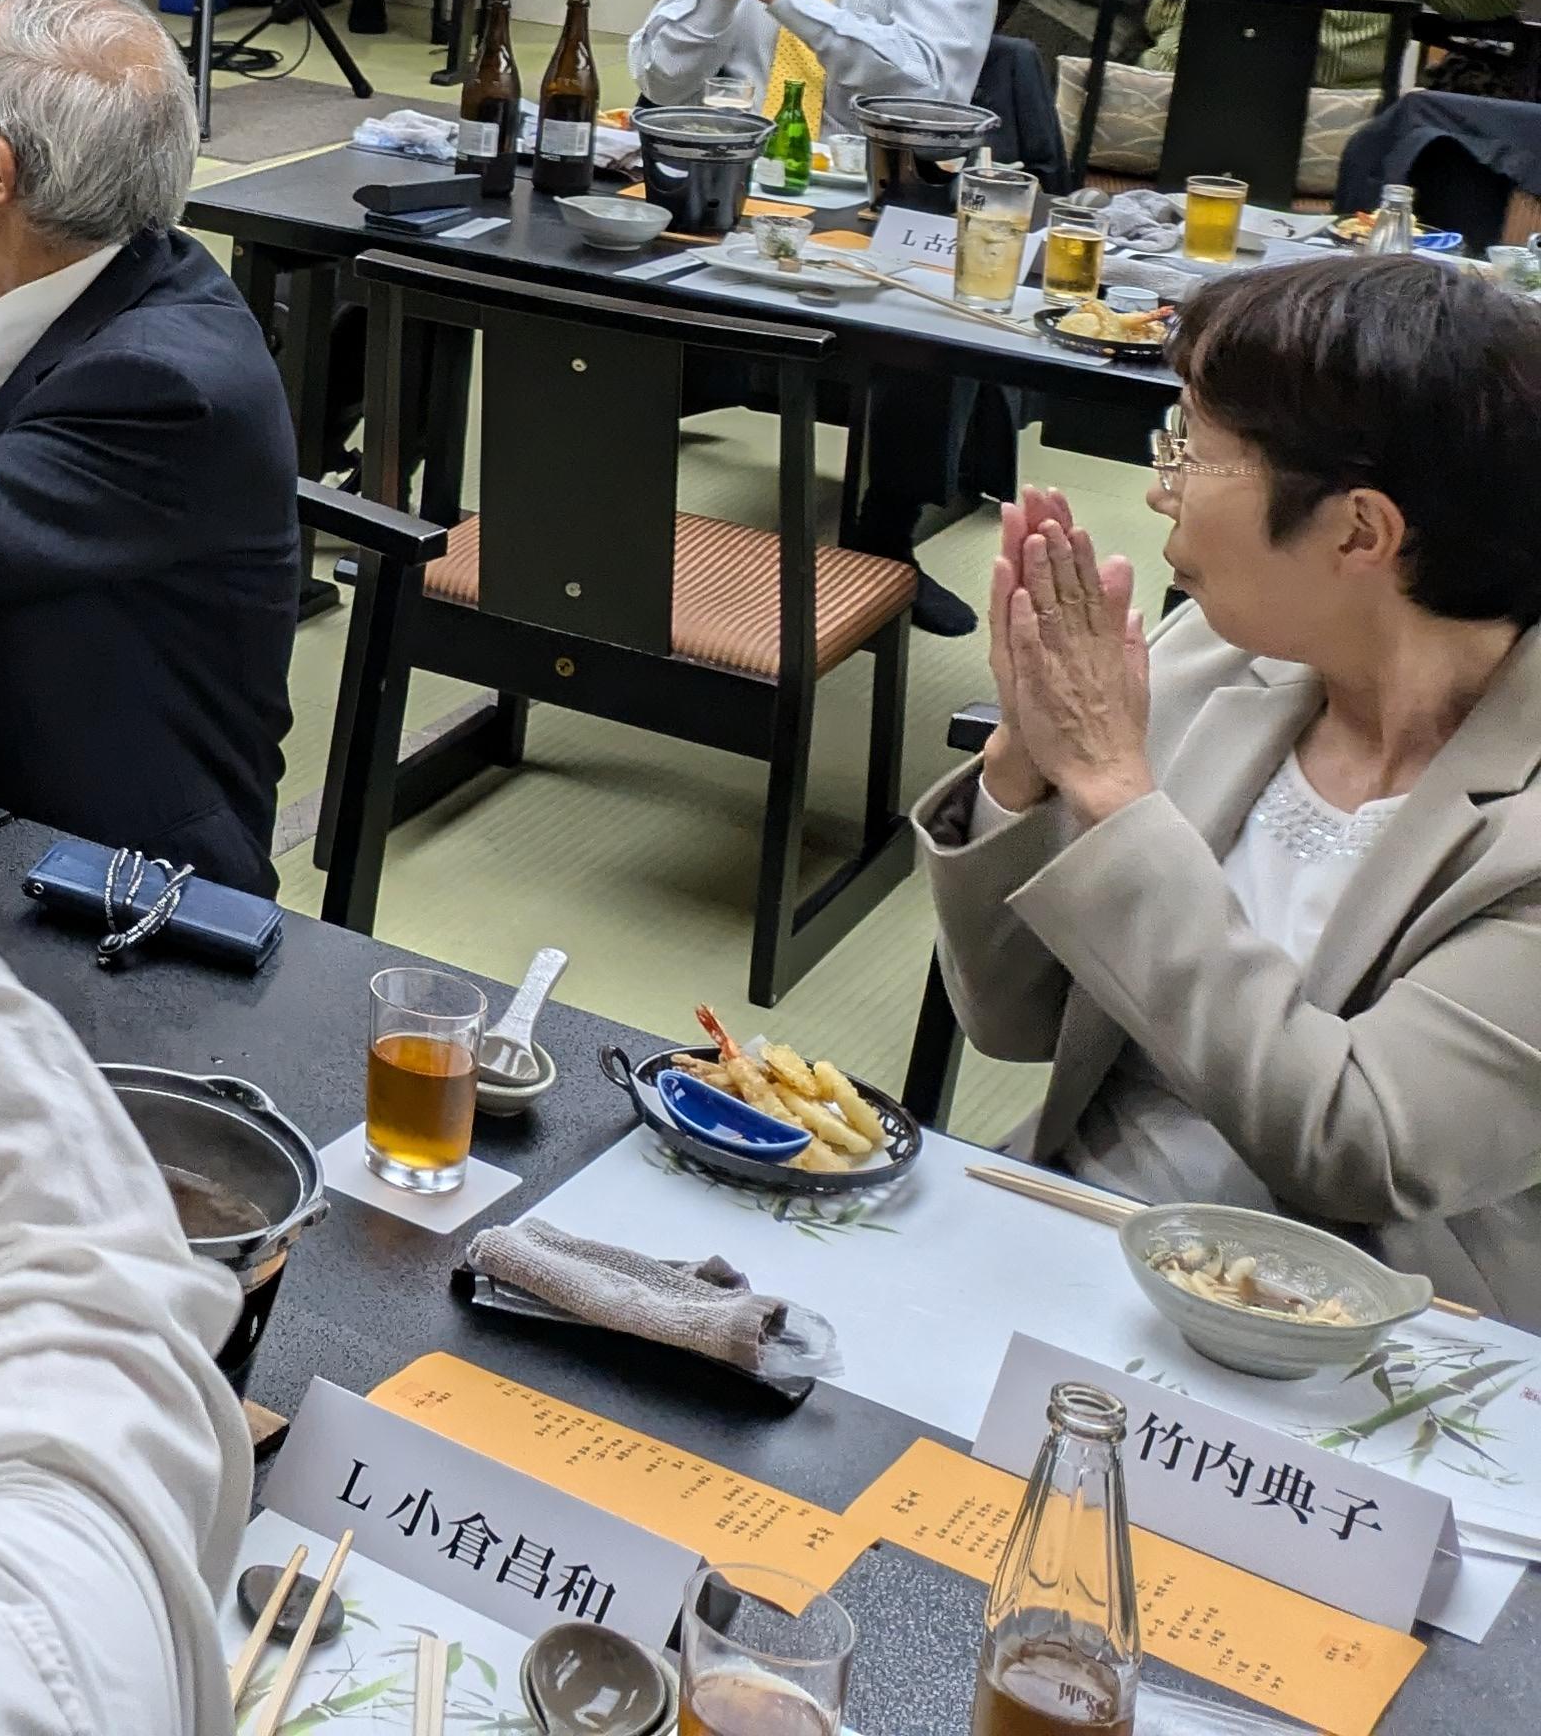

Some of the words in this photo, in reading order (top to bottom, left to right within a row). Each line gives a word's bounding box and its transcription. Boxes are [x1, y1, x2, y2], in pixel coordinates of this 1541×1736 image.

[336, 1458, 373, 1512] L
[385, 1487, 617, 1625] 小倉昌和
[1134, 1411, 1383, 1541] 竹内典子
